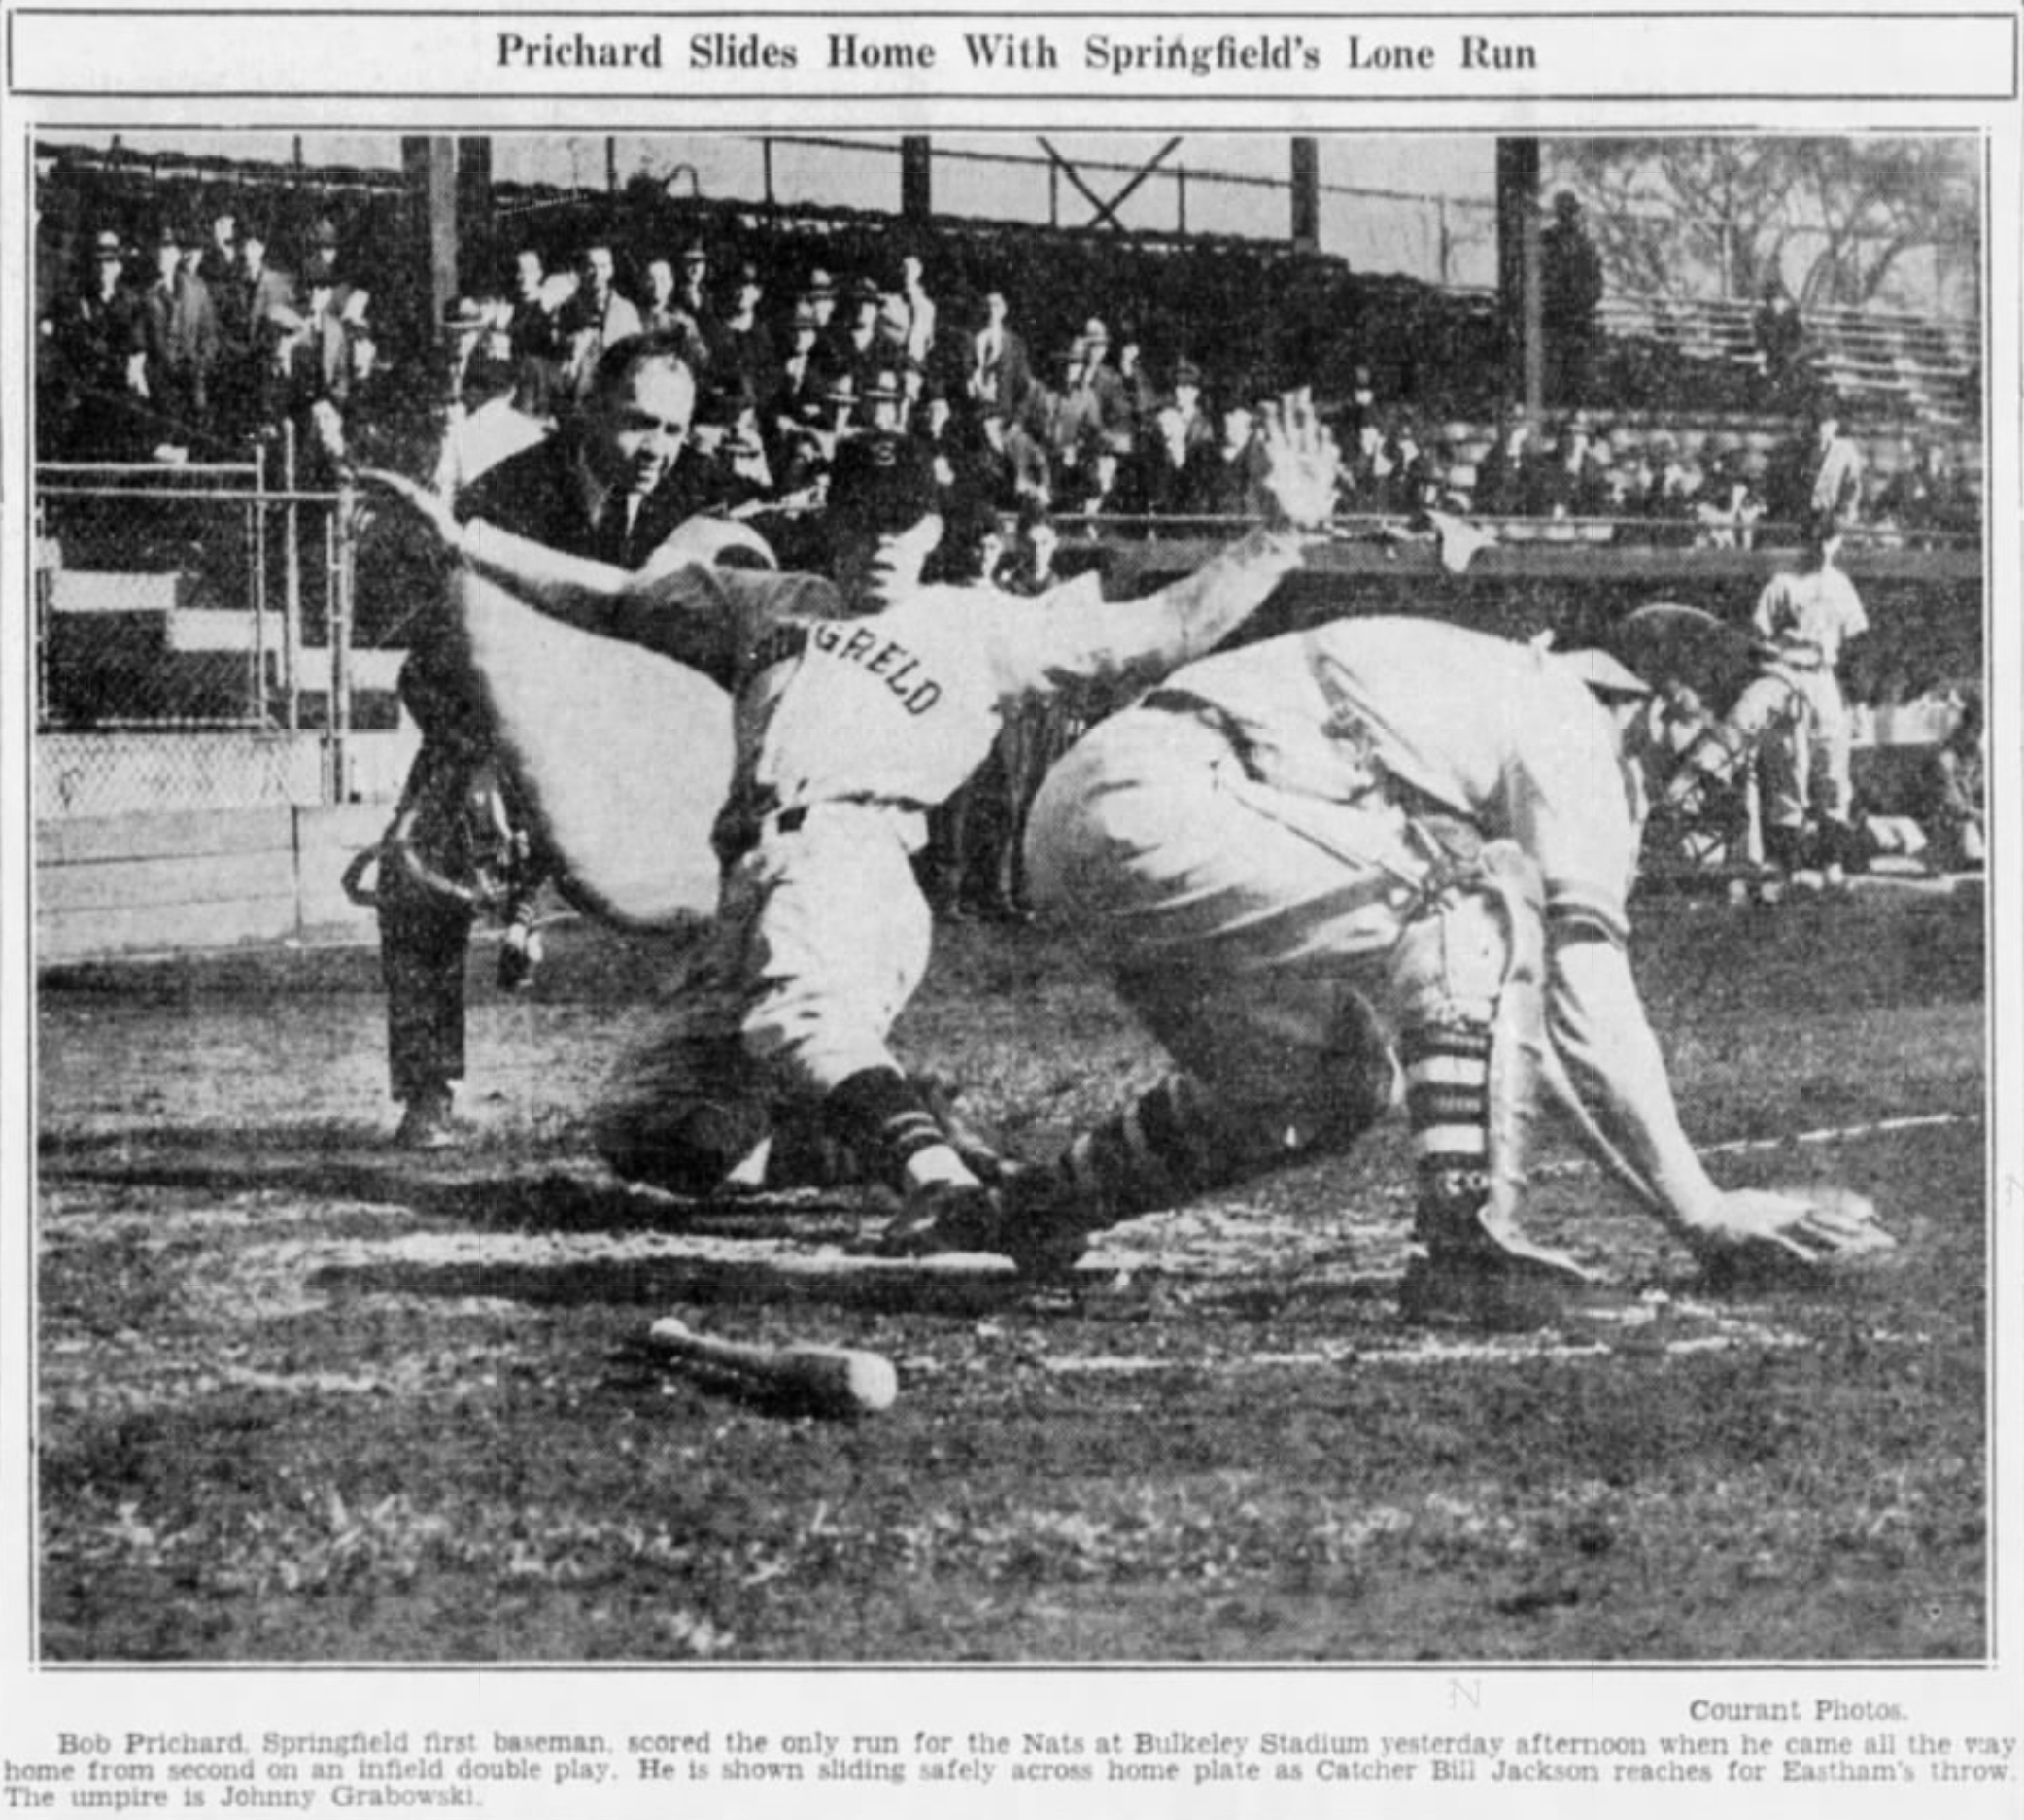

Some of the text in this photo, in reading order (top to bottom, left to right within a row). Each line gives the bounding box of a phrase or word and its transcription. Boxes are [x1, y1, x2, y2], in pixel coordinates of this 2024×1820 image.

[496, 31, 1538, 77] Prichard Slides Home With Springfield's Lone Run
[1689, 1699, 1908, 1721] Courant Photos.
[56, 1732, 112, 1755] Bob
[261, 1731, 409, 1760] Springfield
[423, 1731, 477, 1755] first
[627, 1731, 711, 1755] scored
[725, 1731, 769, 1755] the
[780, 1731, 840, 1760] only
[852, 1735, 899, 1755] run
[913, 1731, 953, 1755] for
[967, 1731, 1011, 1755] the
[1021, 1732, 1085, 1755] Nats
[1094, 1733, 1123, 1755] at
[1133, 1731, 1249, 1760] Bulkeley
[1259, 1732, 1369, 1755] Stadium
[1381, 1733, 1504, 1760] yesterday
[1516, 1732, 1647, 1755] afternoon
[1659, 1733, 1729, 1755] when
[1740, 1733, 1773, 1755] he
[1784, 1736, 1853, 1755] came
[1864, 1733, 1896, 1755] all
[1907, 1733, 1952, 1755] the
[3, 1758, 2018, 1786] home from second on an infield double play. He is shown sliding safely across home plate as Catcher Bill Jackson reaches for Eastham's throw.
[3, 1785, 484, 1812] The umpire is Johnny Grabowski.
